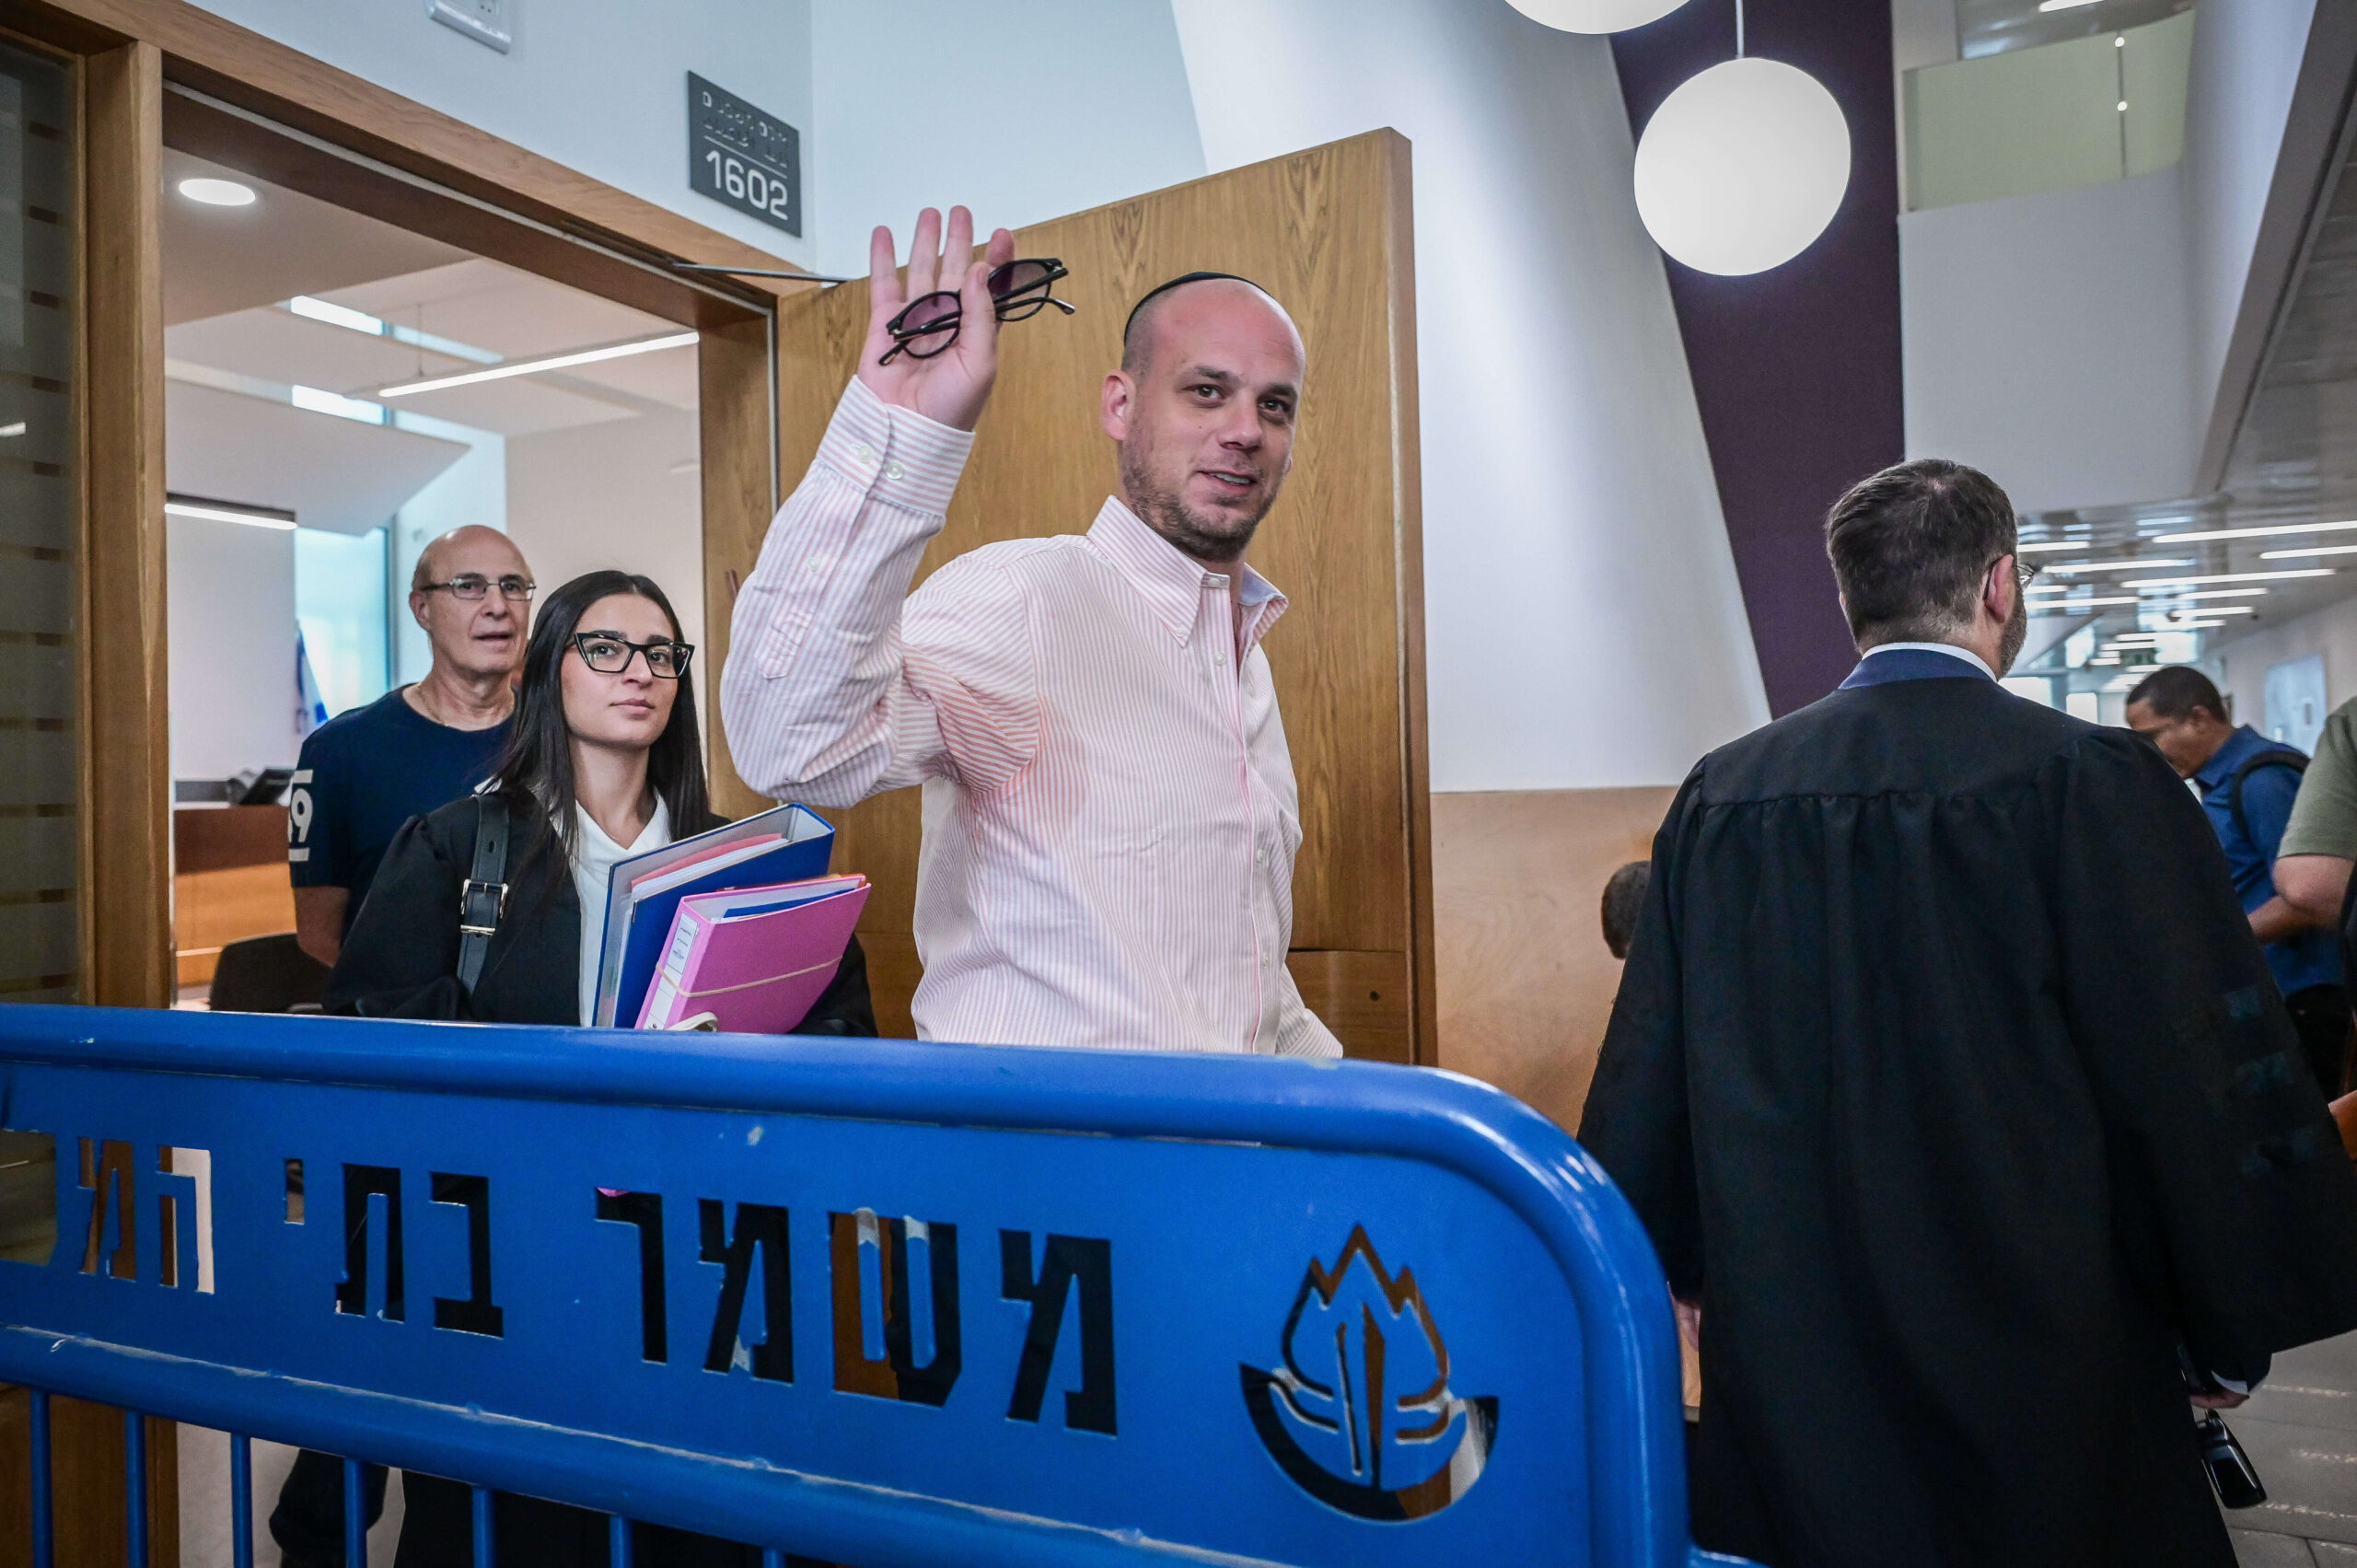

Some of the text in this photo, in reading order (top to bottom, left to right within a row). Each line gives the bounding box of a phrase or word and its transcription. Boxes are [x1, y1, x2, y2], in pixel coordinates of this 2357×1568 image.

[705, 150, 788, 220] 1602
[284, 1157, 504, 1340] בתי
[594, 1187, 1118, 1437] משמר
